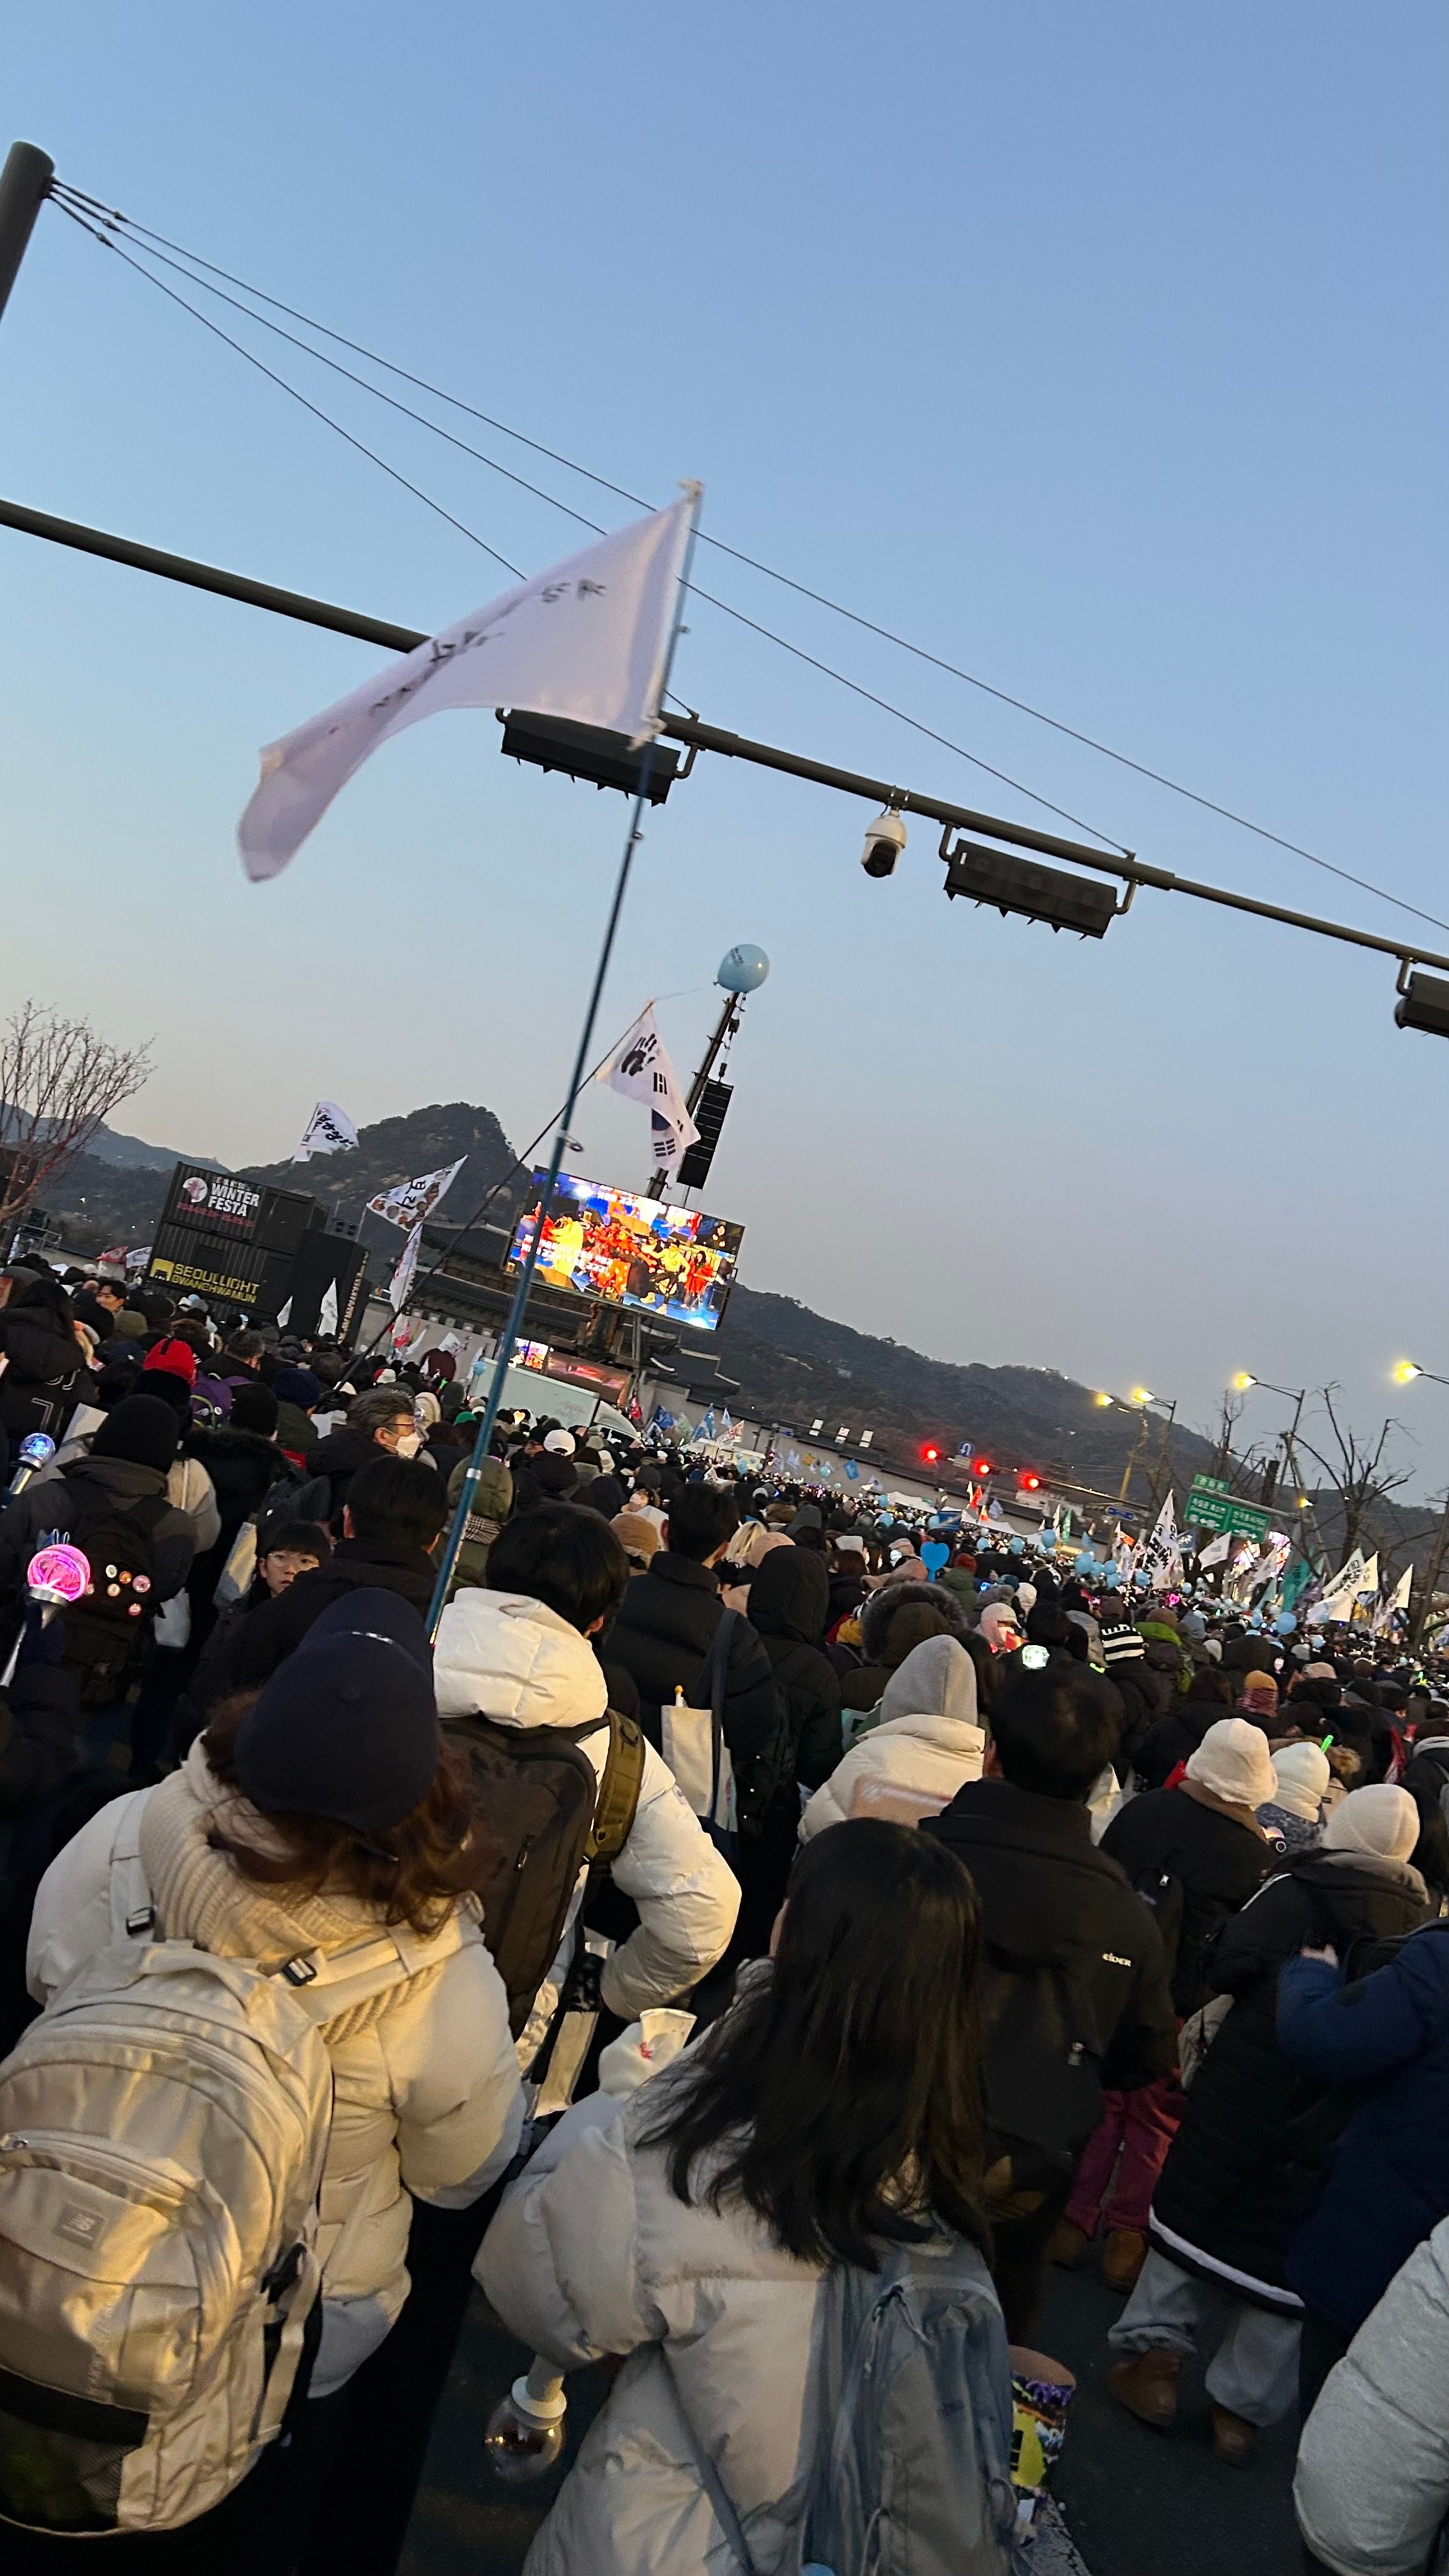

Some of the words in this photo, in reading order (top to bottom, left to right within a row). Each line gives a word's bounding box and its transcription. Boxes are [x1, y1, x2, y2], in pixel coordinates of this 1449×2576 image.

[208, 1195, 247, 1216] FESTA
[211, 1183, 260, 1207] WINTER
[174, 1263, 260, 1294] SEOULLIGHT
